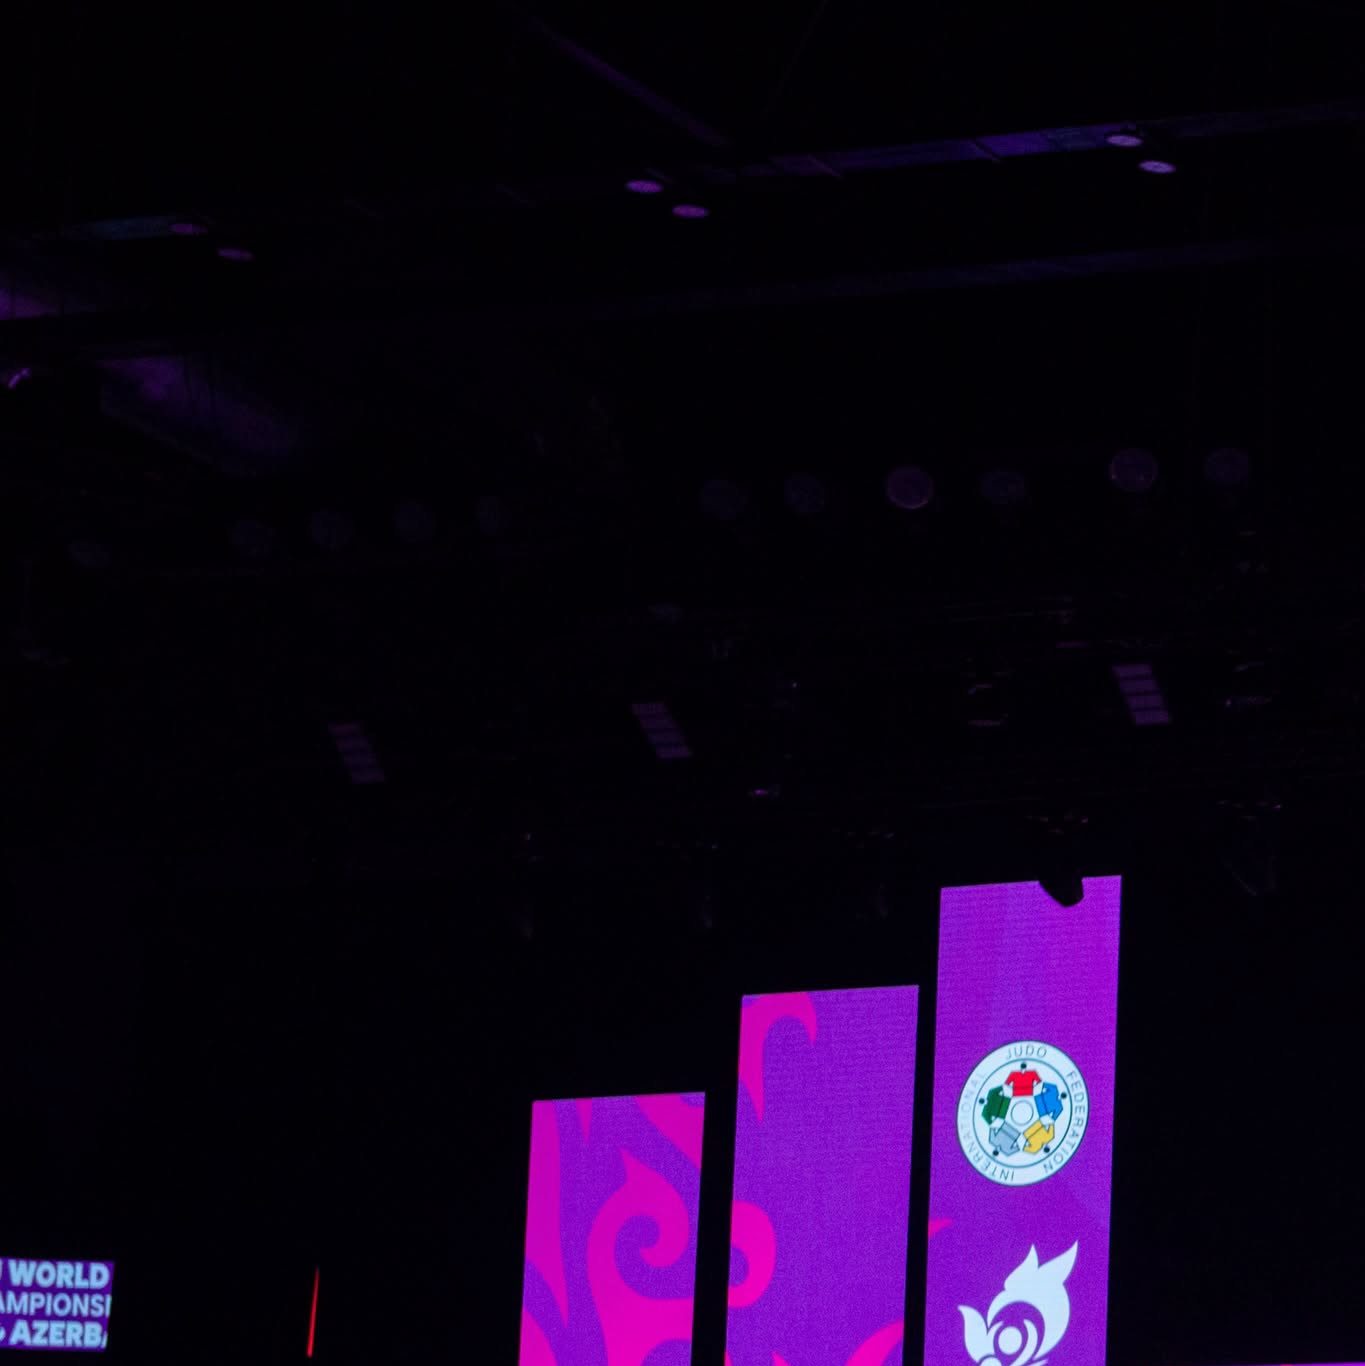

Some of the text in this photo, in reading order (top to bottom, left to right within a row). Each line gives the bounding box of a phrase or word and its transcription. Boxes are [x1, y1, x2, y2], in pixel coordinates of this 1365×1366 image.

[1005, 1043, 1048, 1060] JUDO
[1043, 1070, 1086, 1174] FEDERATION
[8, 1259, 110, 1290] WORLD
[0, 1291, 112, 1318] MPIONS
